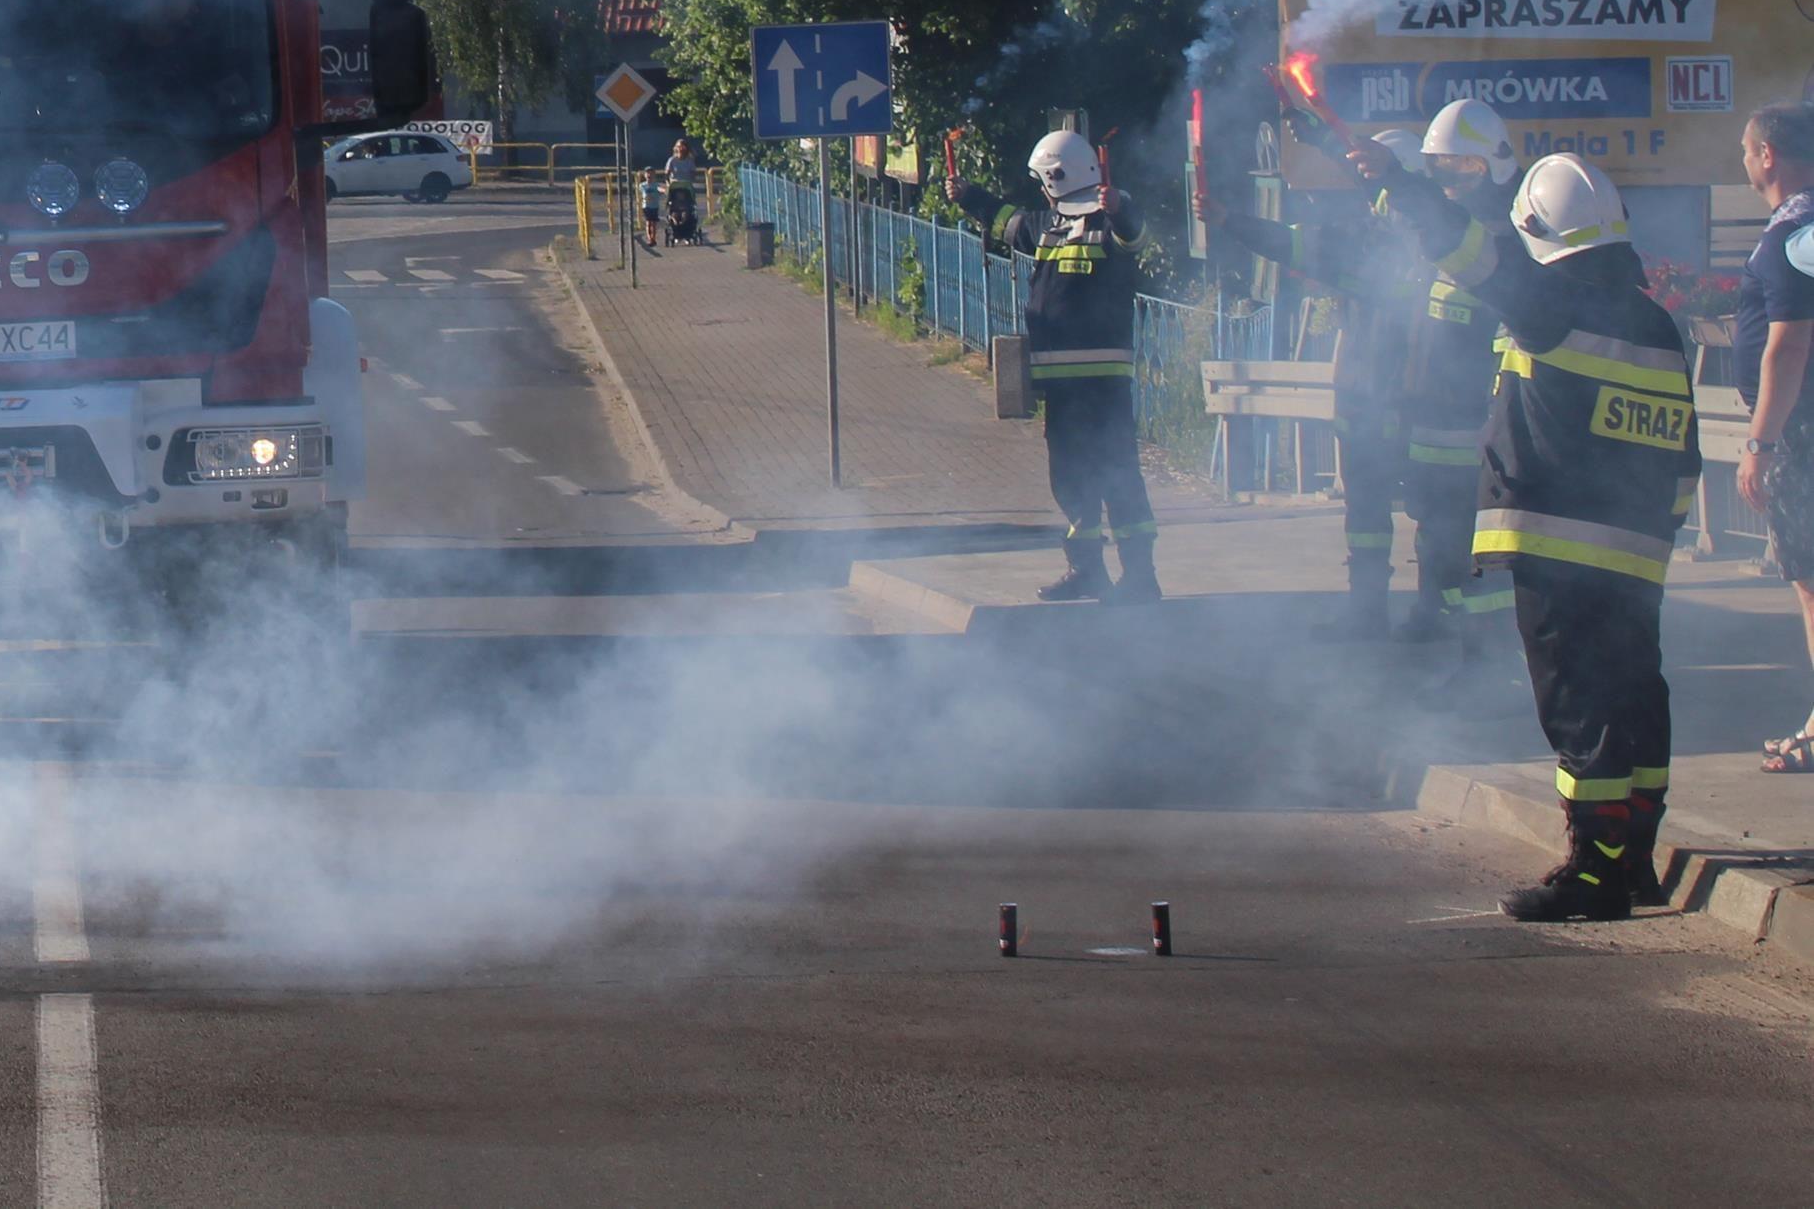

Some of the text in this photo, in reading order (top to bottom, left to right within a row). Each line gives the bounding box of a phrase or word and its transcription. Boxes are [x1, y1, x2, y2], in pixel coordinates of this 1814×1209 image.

[1362, 69, 1609, 119] psb MRÓWKA
[1673, 64, 1726, 101] NCL
[395, 123, 486, 134] ODOLOG
[1523, 130, 1666, 157] Maja 1 F
